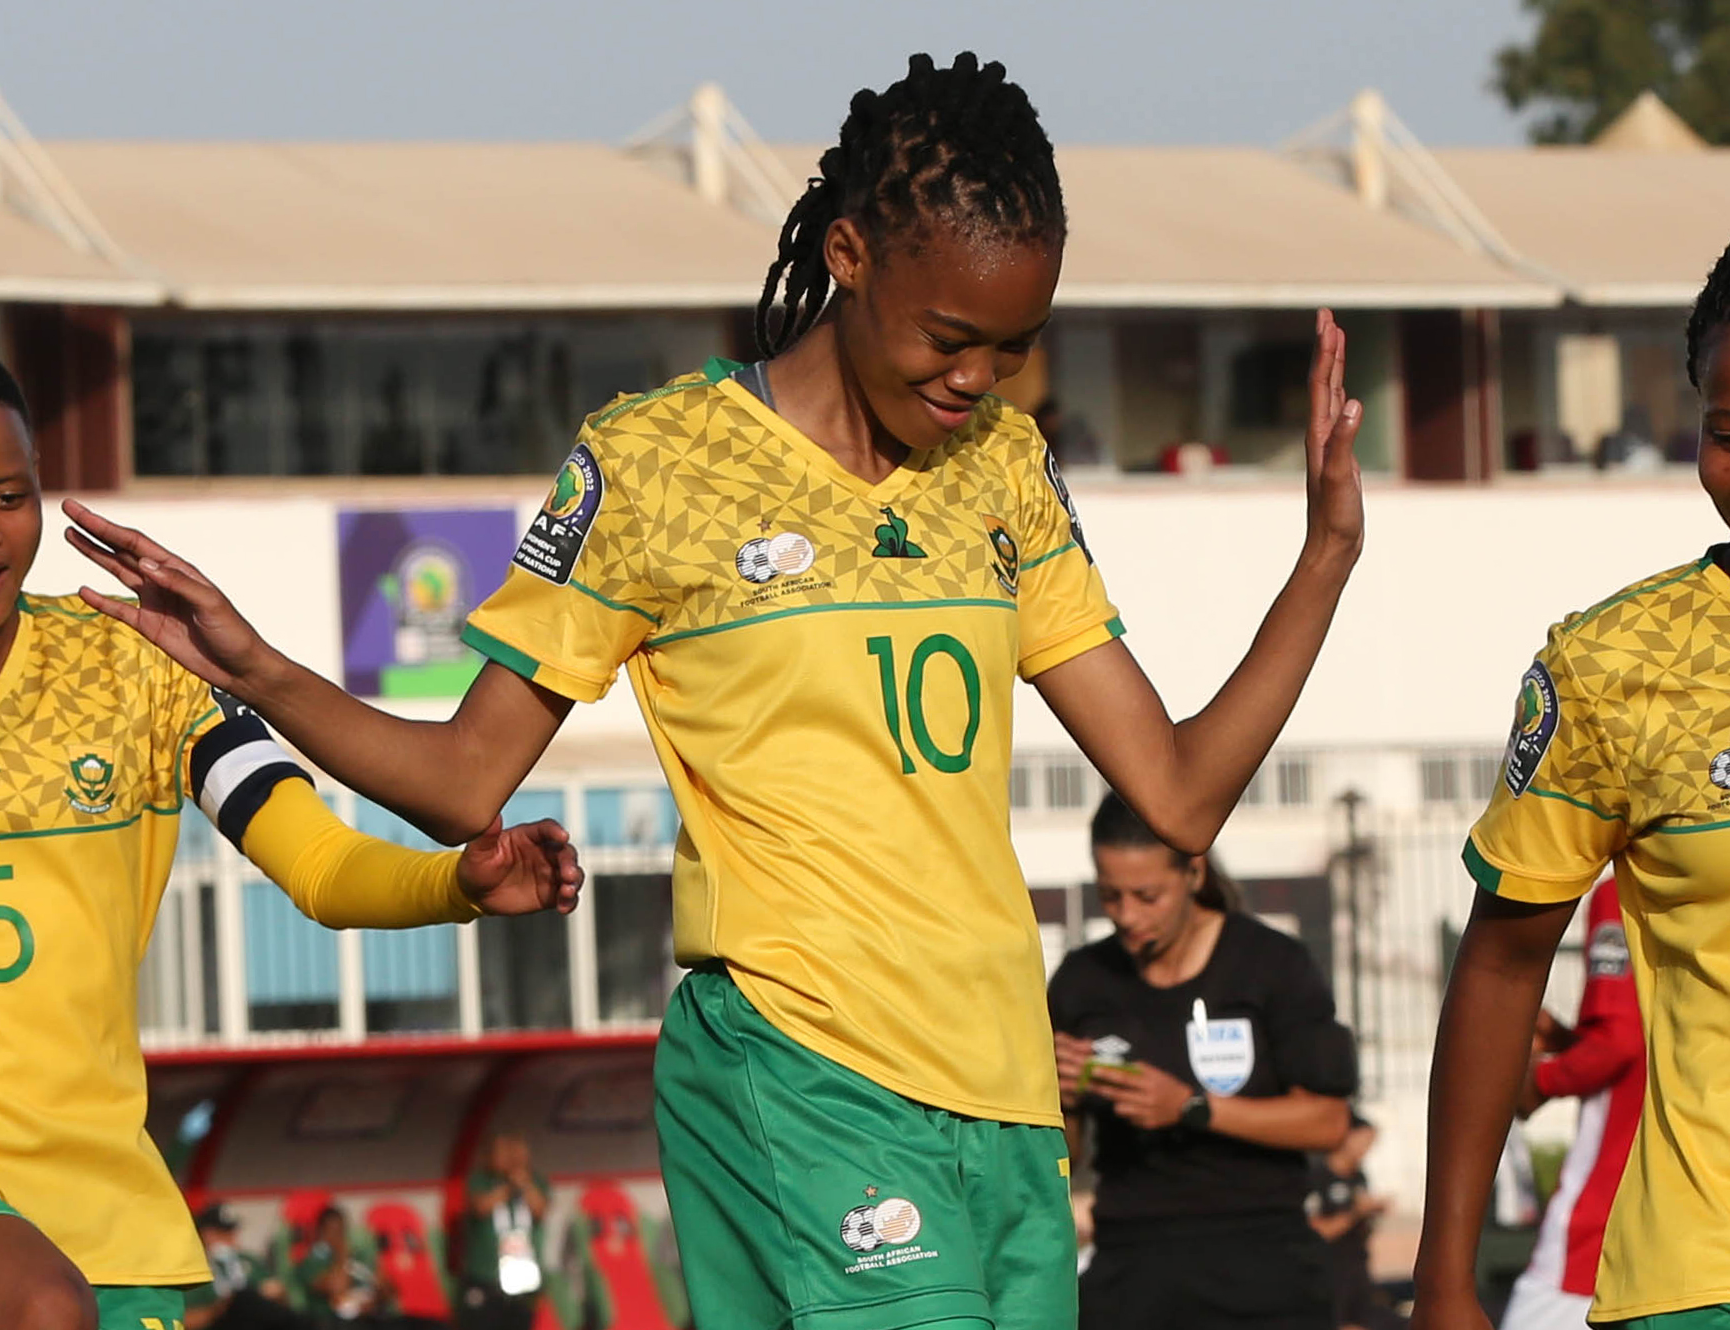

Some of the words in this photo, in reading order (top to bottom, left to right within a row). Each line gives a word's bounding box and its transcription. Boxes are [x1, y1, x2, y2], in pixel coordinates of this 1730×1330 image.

[535, 515, 566, 536] AF
[523, 556, 558, 577] NATIONS
[866, 633, 981, 775] 10
[844, 1261, 885, 1275] FOOTBALL
[886, 1250, 939, 1267] ASSOCIATION
[857, 1252, 884, 1264] SOUTH
[886, 1245, 921, 1260] AFRICAN
